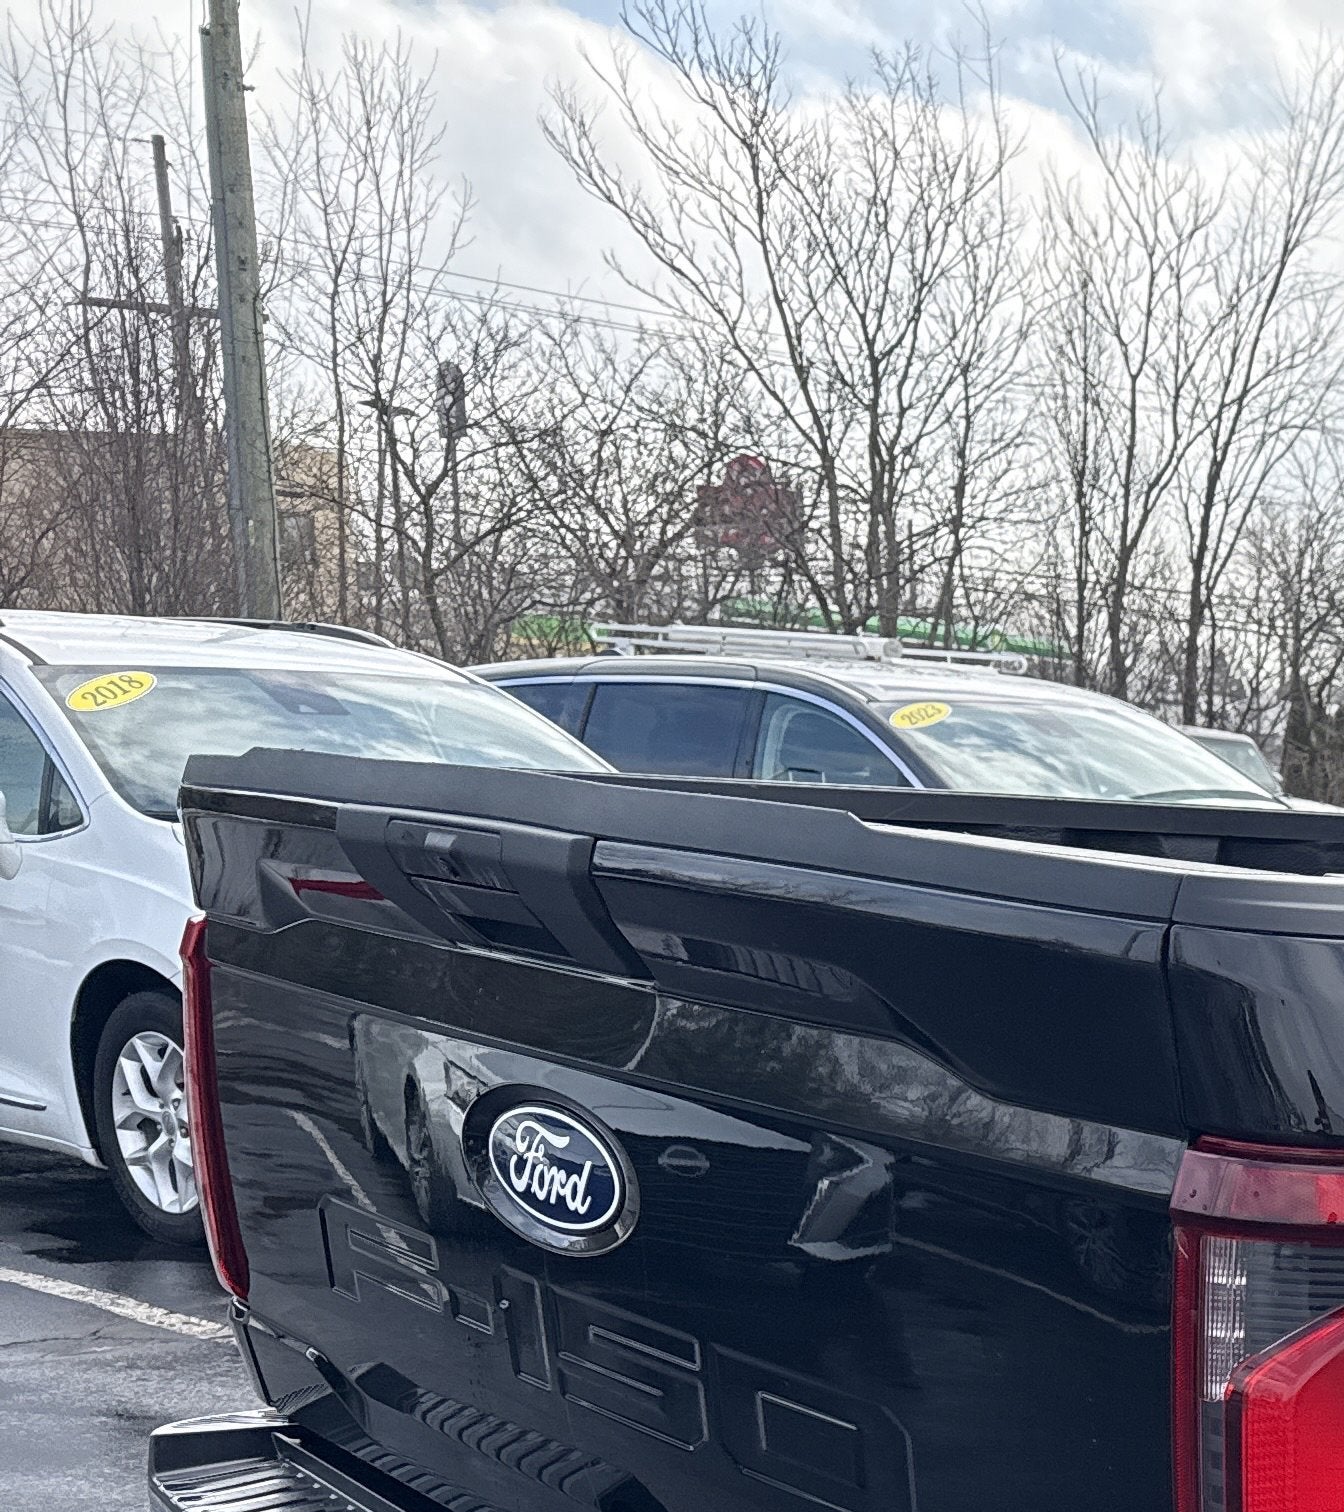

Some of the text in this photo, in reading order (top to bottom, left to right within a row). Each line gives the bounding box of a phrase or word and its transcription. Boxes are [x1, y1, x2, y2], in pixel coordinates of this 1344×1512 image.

[81, 674, 145, 707] 2018
[900, 703, 943, 726] 2023
[509, 1119, 593, 1216] Ford
